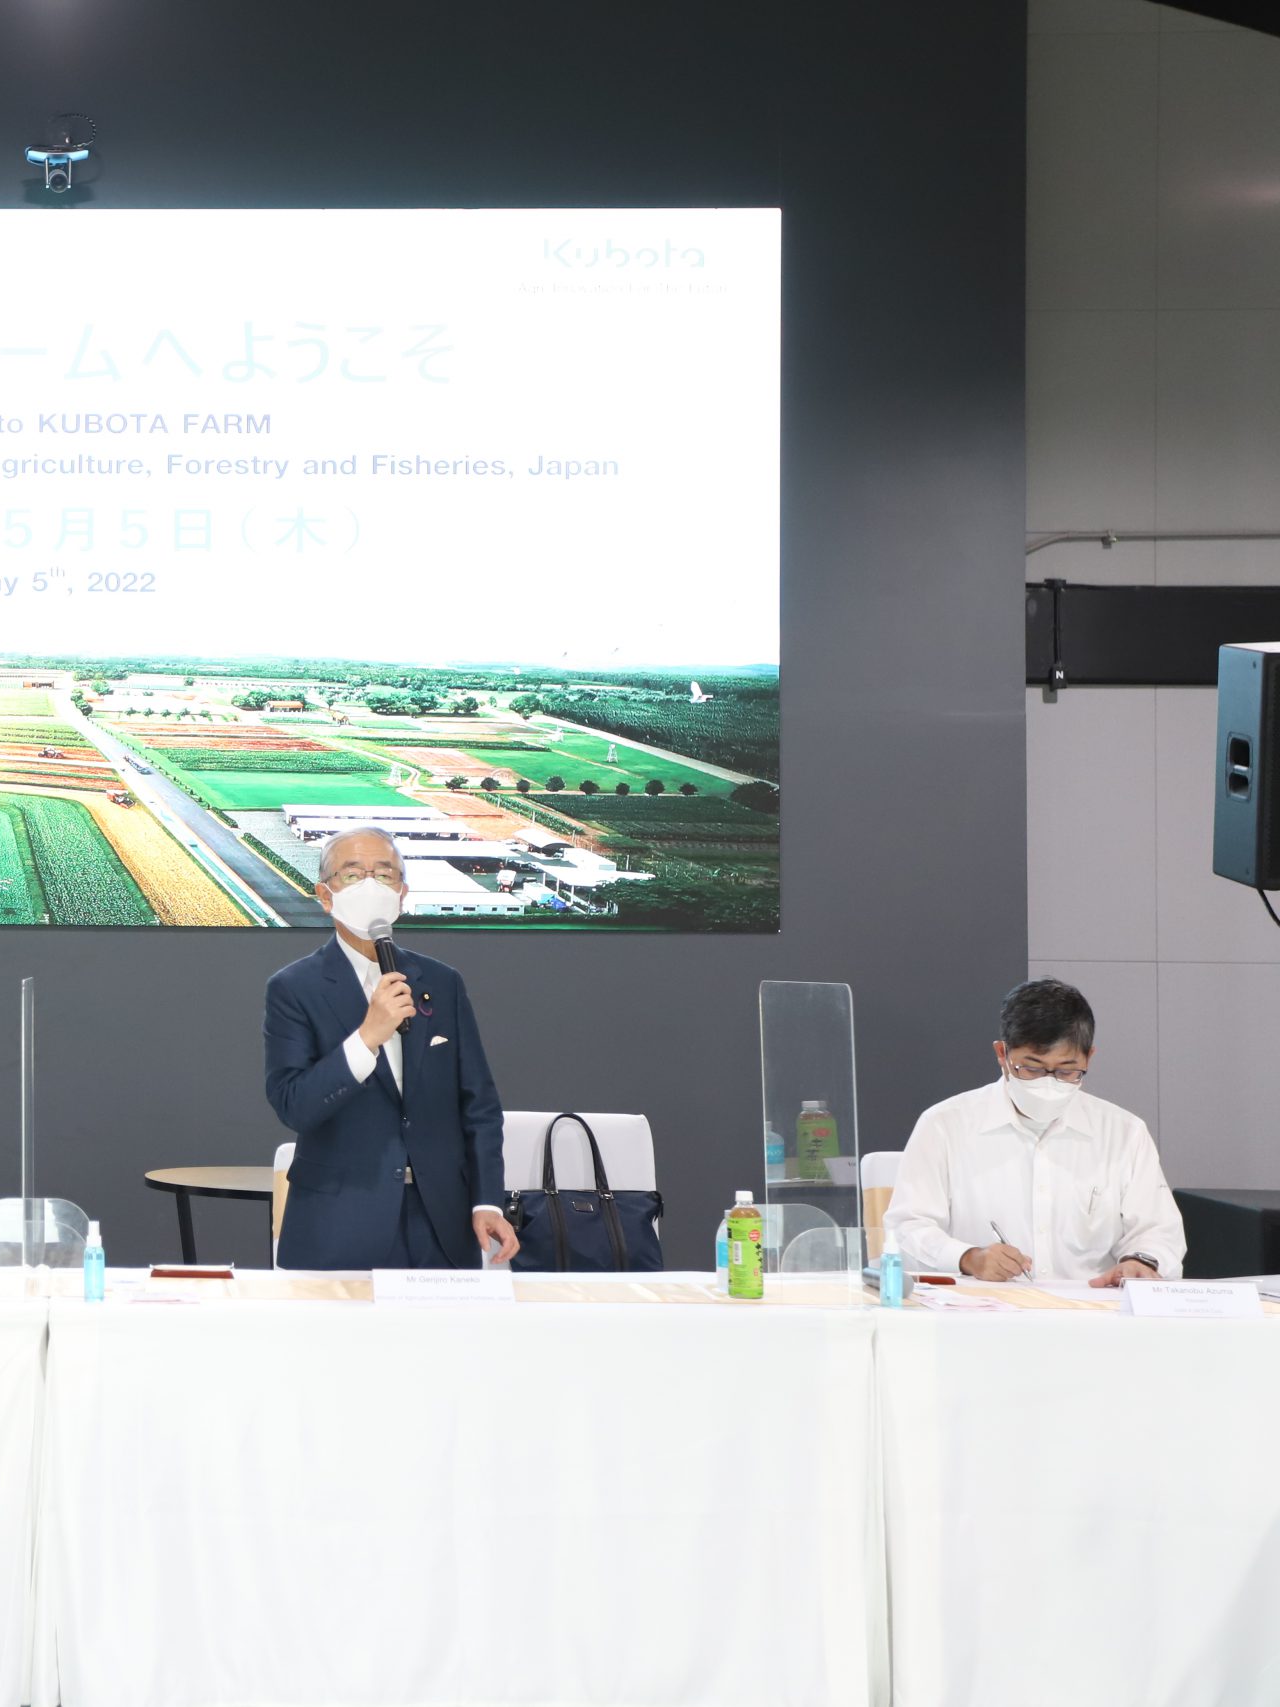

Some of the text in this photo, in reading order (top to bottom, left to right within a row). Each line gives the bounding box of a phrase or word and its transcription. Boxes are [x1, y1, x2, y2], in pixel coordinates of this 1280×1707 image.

[543, 238, 705, 268] Kubota
[38, 414, 169, 434] KUBOTA
[184, 414, 271, 435] FARM
[167, 454, 288, 479] Forestry
[303, 455, 356, 475] and
[372, 455, 513, 479] Fisheries,
[527, 456, 619, 480] Japan
[87, 572, 157, 593] 2022
